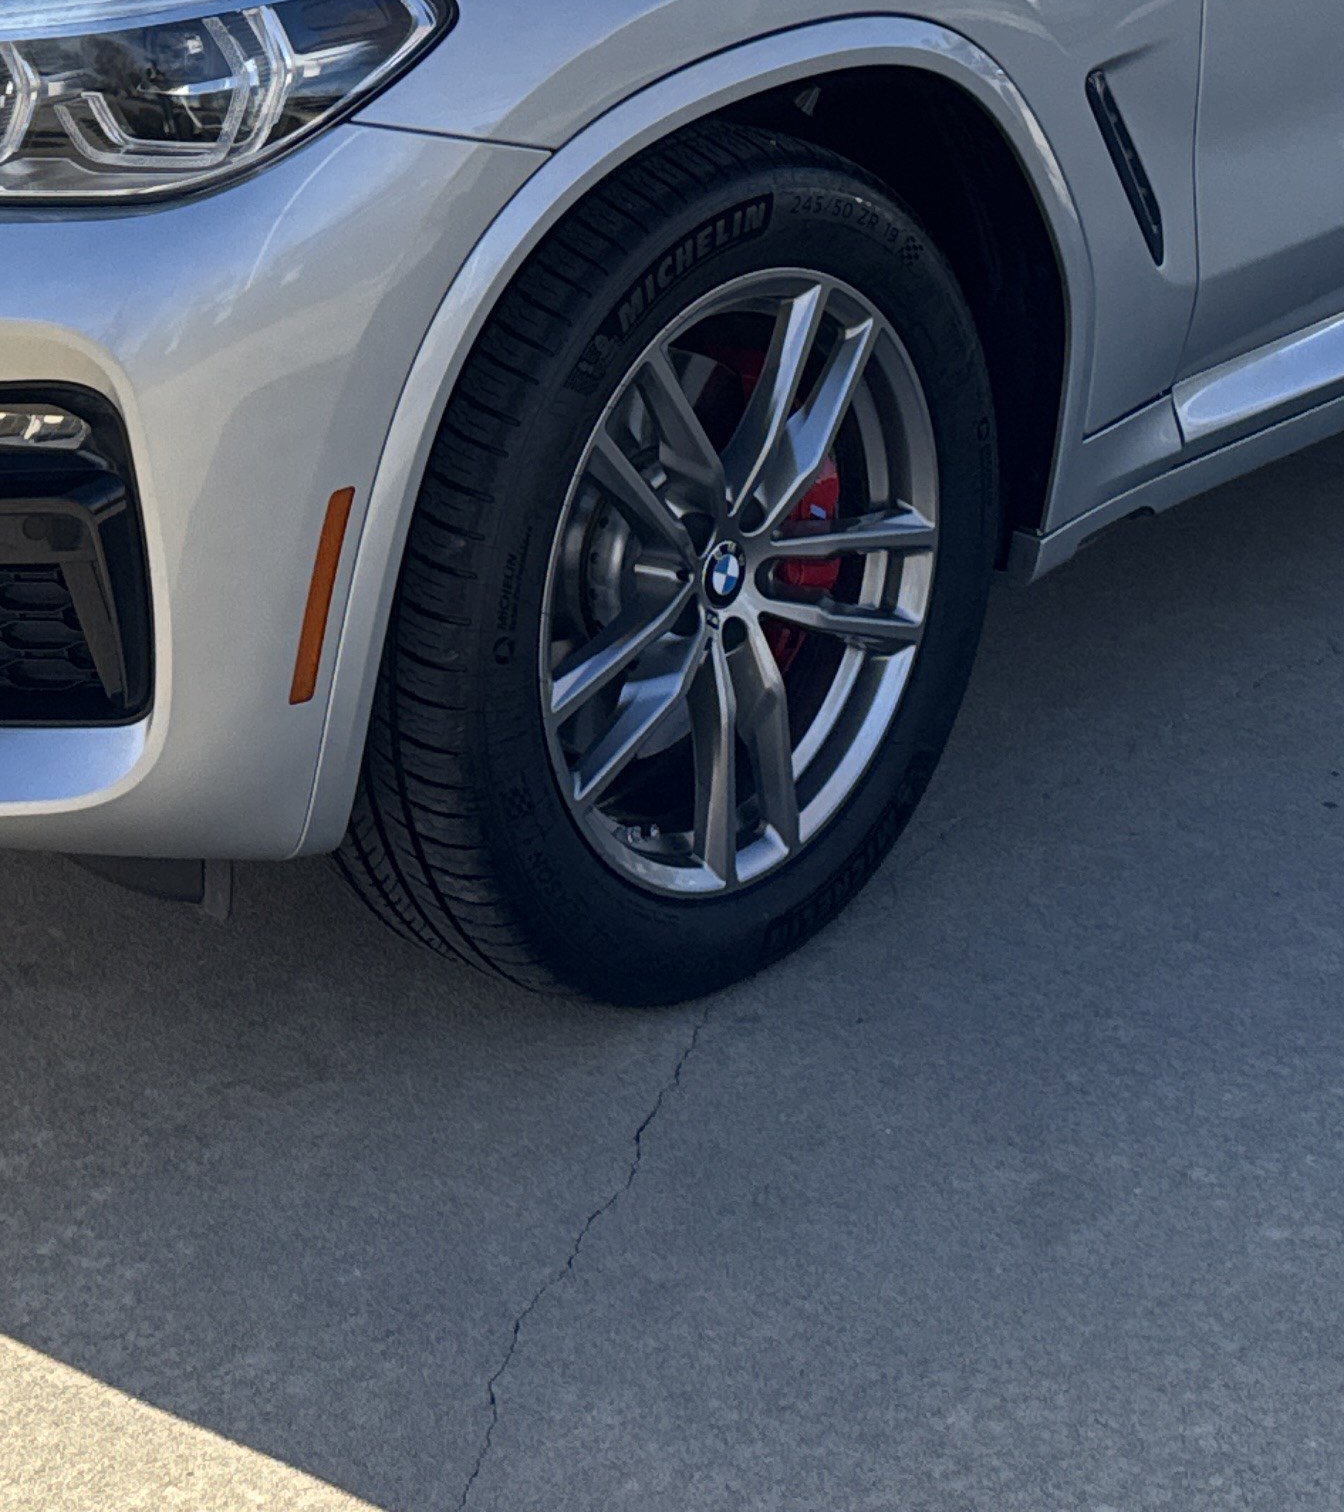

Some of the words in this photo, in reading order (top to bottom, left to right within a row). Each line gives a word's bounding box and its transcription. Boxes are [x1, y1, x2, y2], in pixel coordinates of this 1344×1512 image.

[789, 194, 854, 220] 245/50
[856, 200, 880, 230] ZR
[885, 221, 900, 244] 19
[616, 201, 768, 335] MICHELIN
